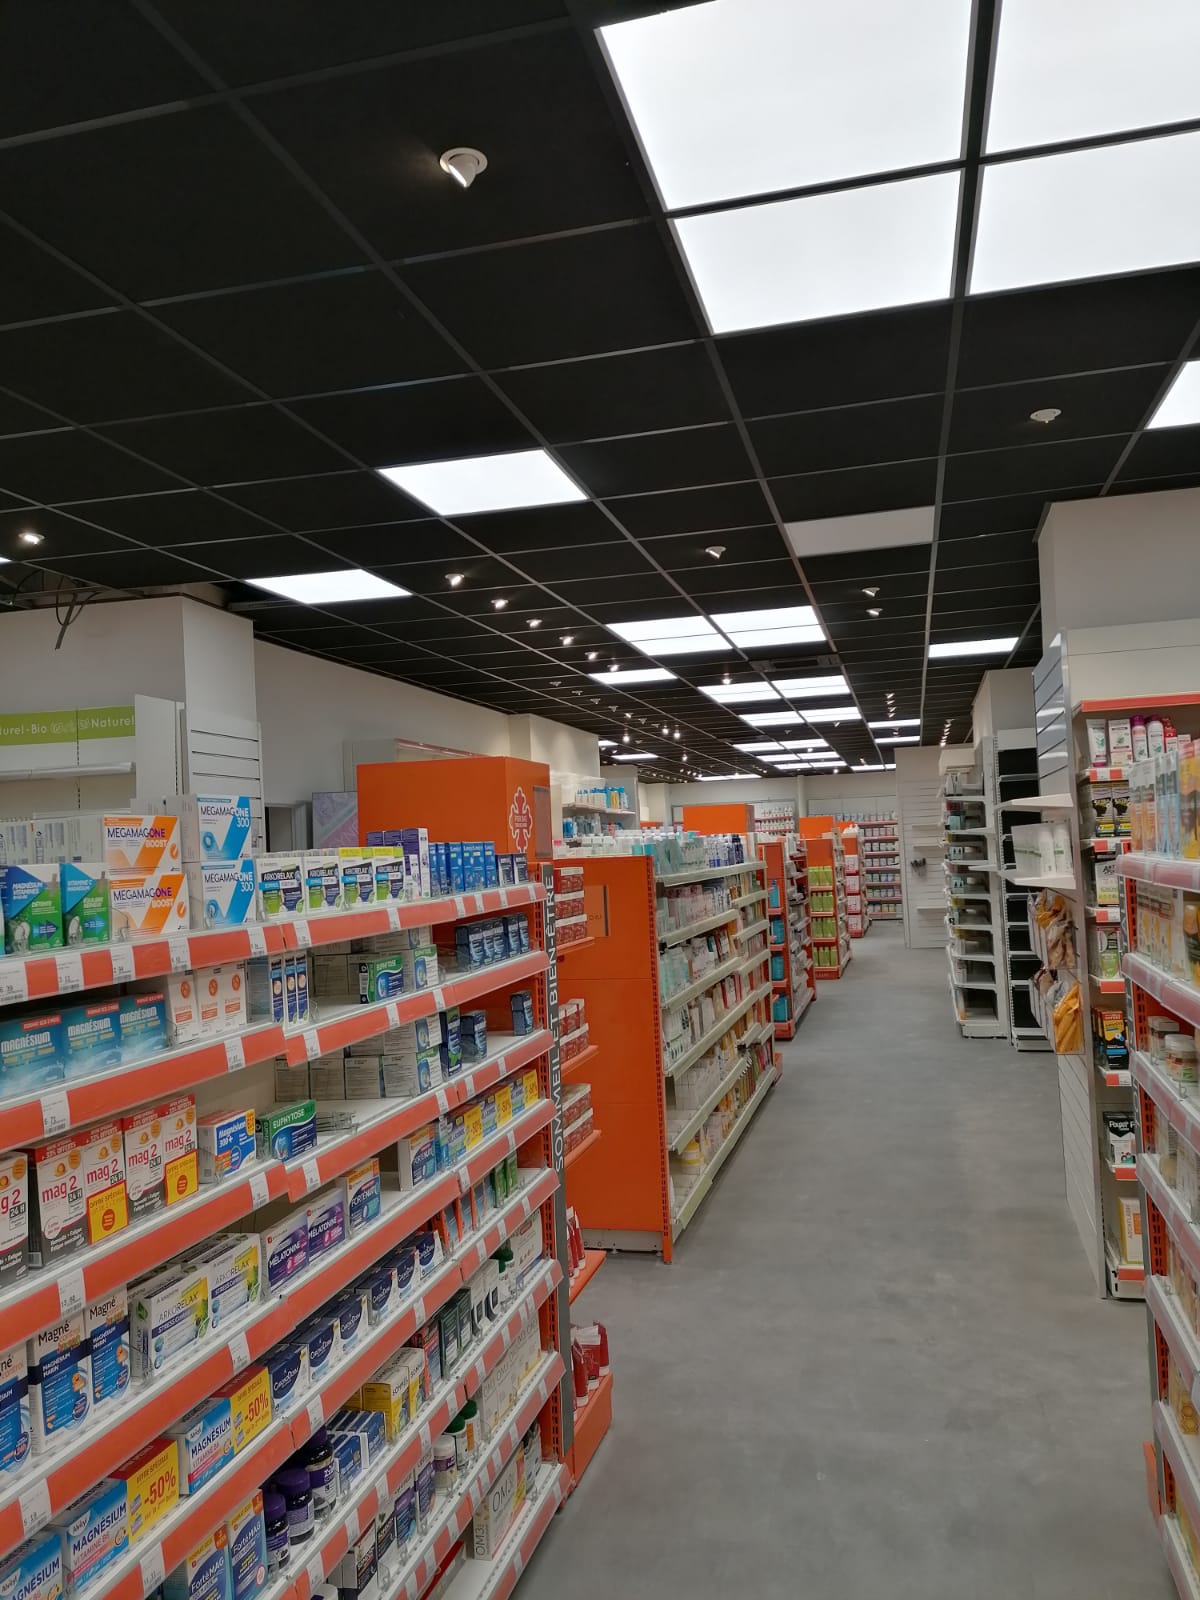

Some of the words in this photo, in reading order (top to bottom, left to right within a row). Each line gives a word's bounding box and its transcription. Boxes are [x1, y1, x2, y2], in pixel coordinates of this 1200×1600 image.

[107, 827, 166, 838] MEGAMAGONE
[113, 886, 172, 901] MEGAMAGONE
[544, 875, 559, 1006] BIEN-ÊTRE
[549, 1019, 560, 1043] ET
[272, 1108, 305, 1129] EUPHYTOSE
[551, 1048, 564, 1172] SOMMEIL
[165, 1135, 184, 1152] mag
[185, 1129, 192, 1143] 2
[128, 1147, 150, 1168] mag
[150, 1143, 158, 1158] 2
[86, 1165, 110, 1185] mag
[111, 1158, 119, 1174] 2
[11, 1188, 21, 1205] 2
[41, 1181, 68, 1203] mag
[69, 1175, 78, 1190] 2
[269, 1240, 300, 1268] MÉLATONINE
[89, 1297, 116, 1320] Magné
[38, 1320, 70, 1346] Magné
[245, 1391, 268, 1422] -50%
[191, 1416, 231, 1459] MAGNÉSIUM
[144, 1467, 176, 1504] -50%
[73, 1501, 127, 1555] MAGNÉSIUM
[474, 1524, 486, 1556] OM3
